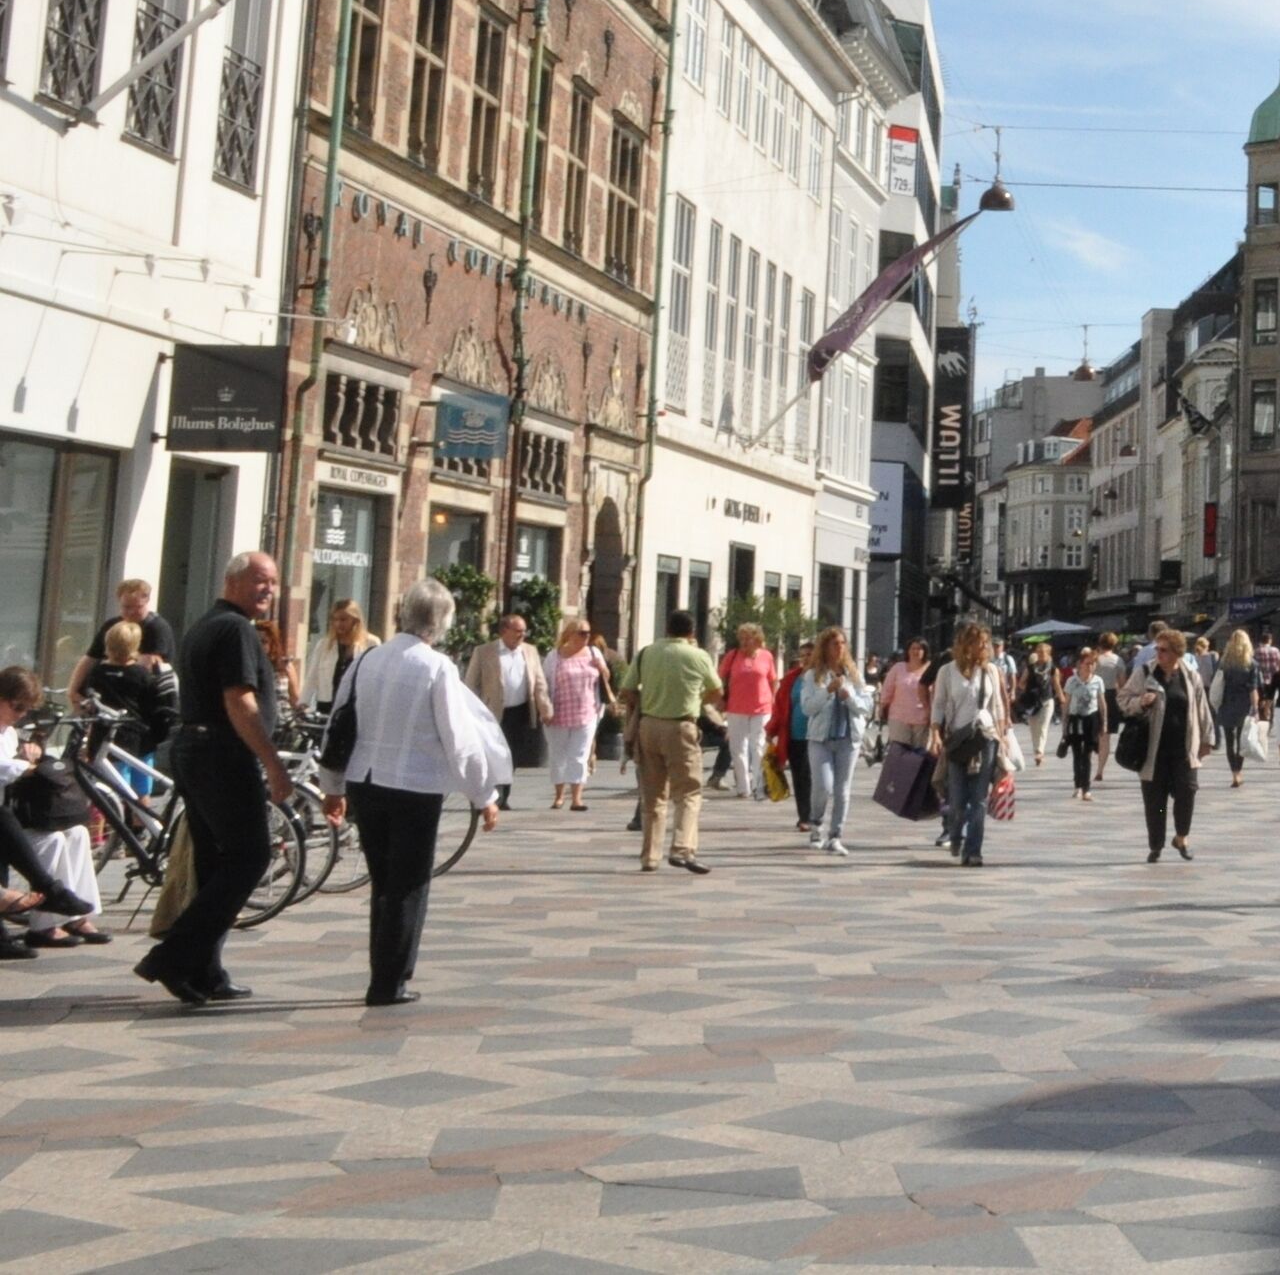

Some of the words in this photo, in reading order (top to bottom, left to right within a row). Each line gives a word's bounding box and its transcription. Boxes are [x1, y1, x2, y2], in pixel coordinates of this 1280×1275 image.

[172, 415, 215, 429] Illums
[217, 416, 276, 433] Bolighus
[938, 404, 962, 485] ILLUM
